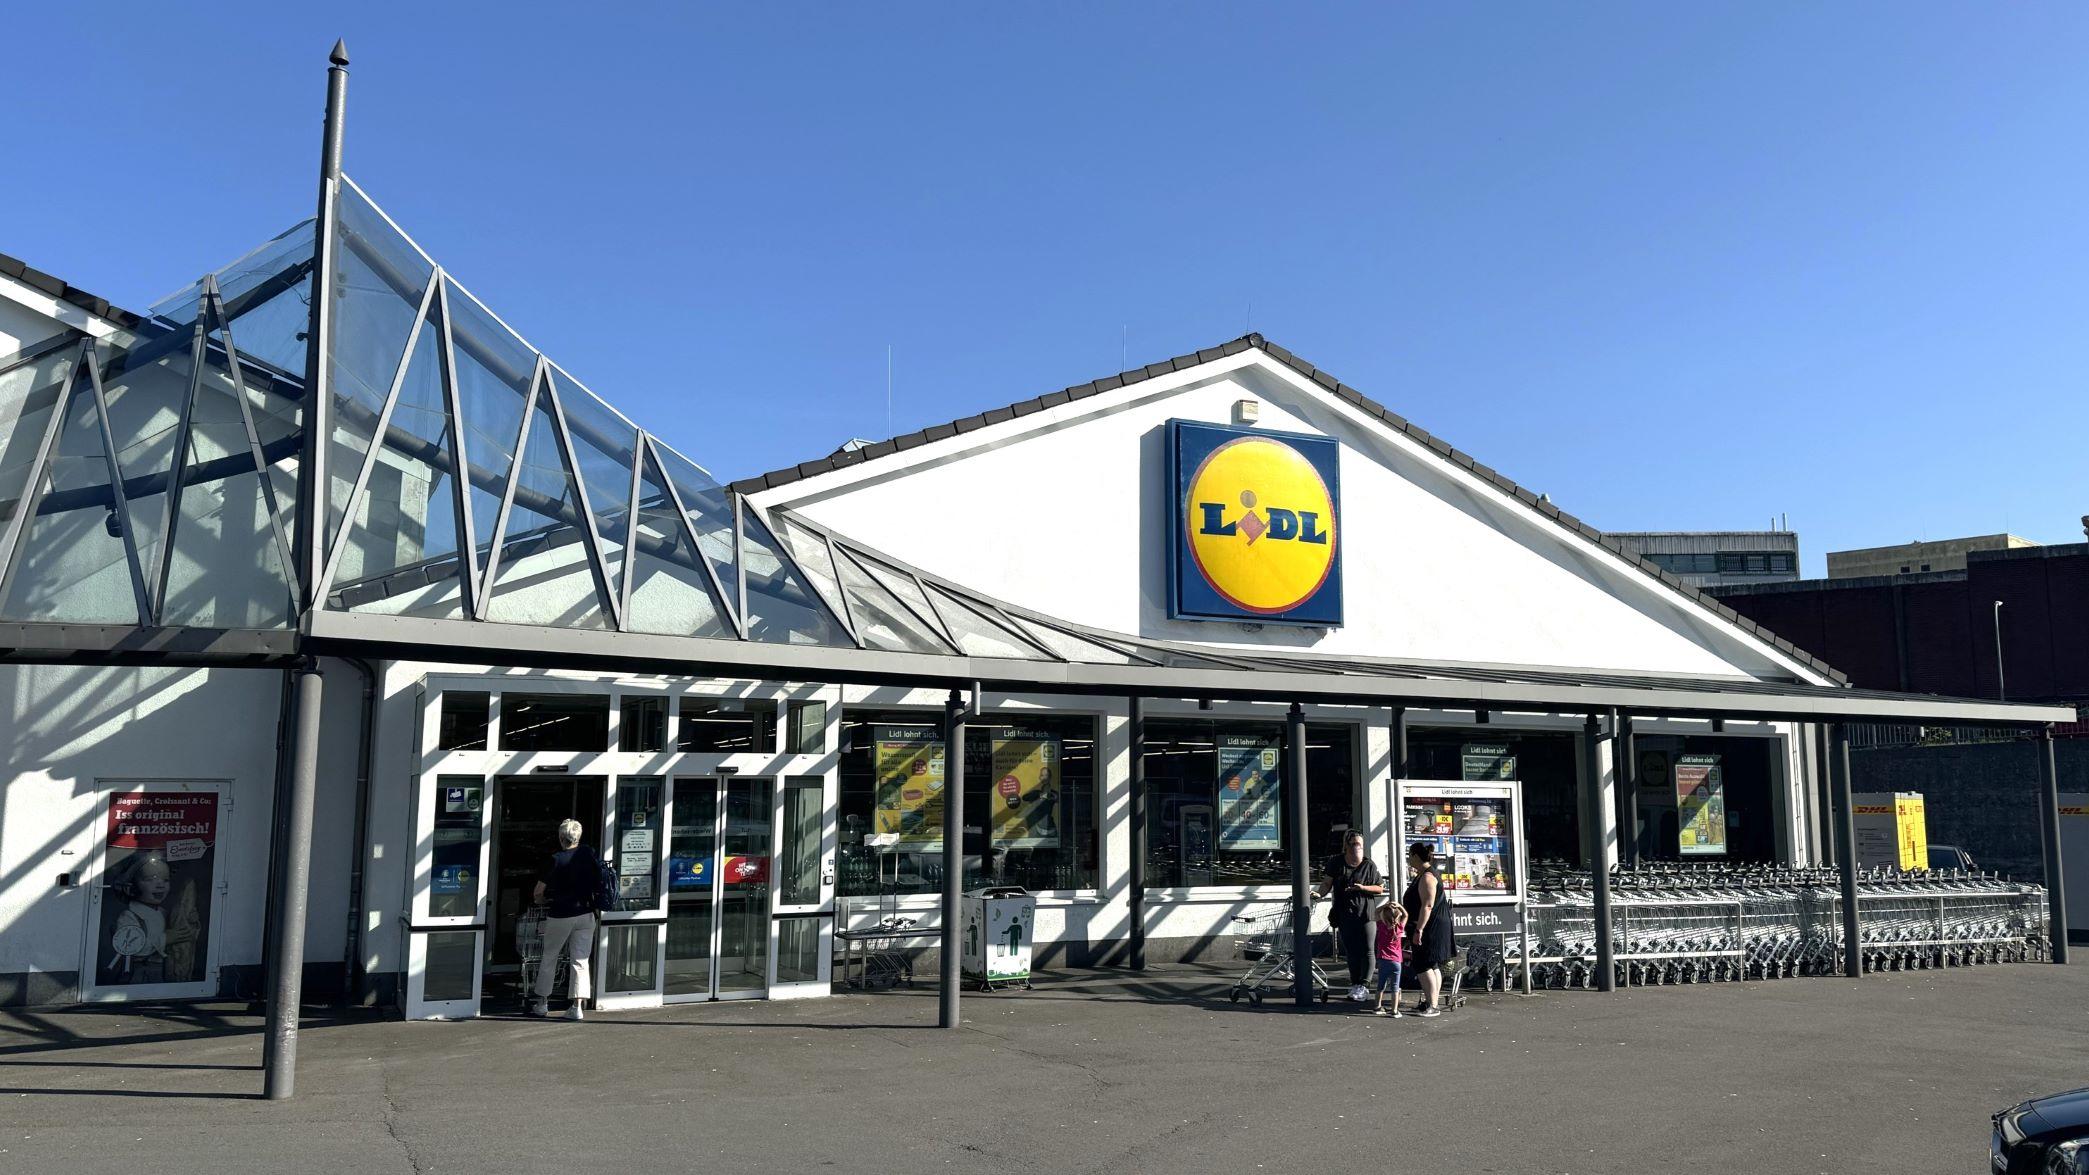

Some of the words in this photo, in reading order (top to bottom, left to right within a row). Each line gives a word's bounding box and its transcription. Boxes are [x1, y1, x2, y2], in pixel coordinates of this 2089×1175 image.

[888, 730, 902, 738] Lidl
[903, 730, 922, 738] lohnt
[1003, 729, 1016, 737] Lidl
[1017, 730, 1034, 738] lohnt
[1240, 738, 1256, 746] lohnt
[1470, 746, 1481, 754] Lidl
[1481, 746, 1496, 754] lohnt
[154, 797, 191, 805] Croissant
[1856, 806, 1889, 814] DHL
[115, 809, 133, 820] Iss
[135, 809, 185, 821] original
[117, 822, 210, 834] französisch!
[1453, 912, 1472, 927] hnt
[1475, 911, 1502, 926] sich.
